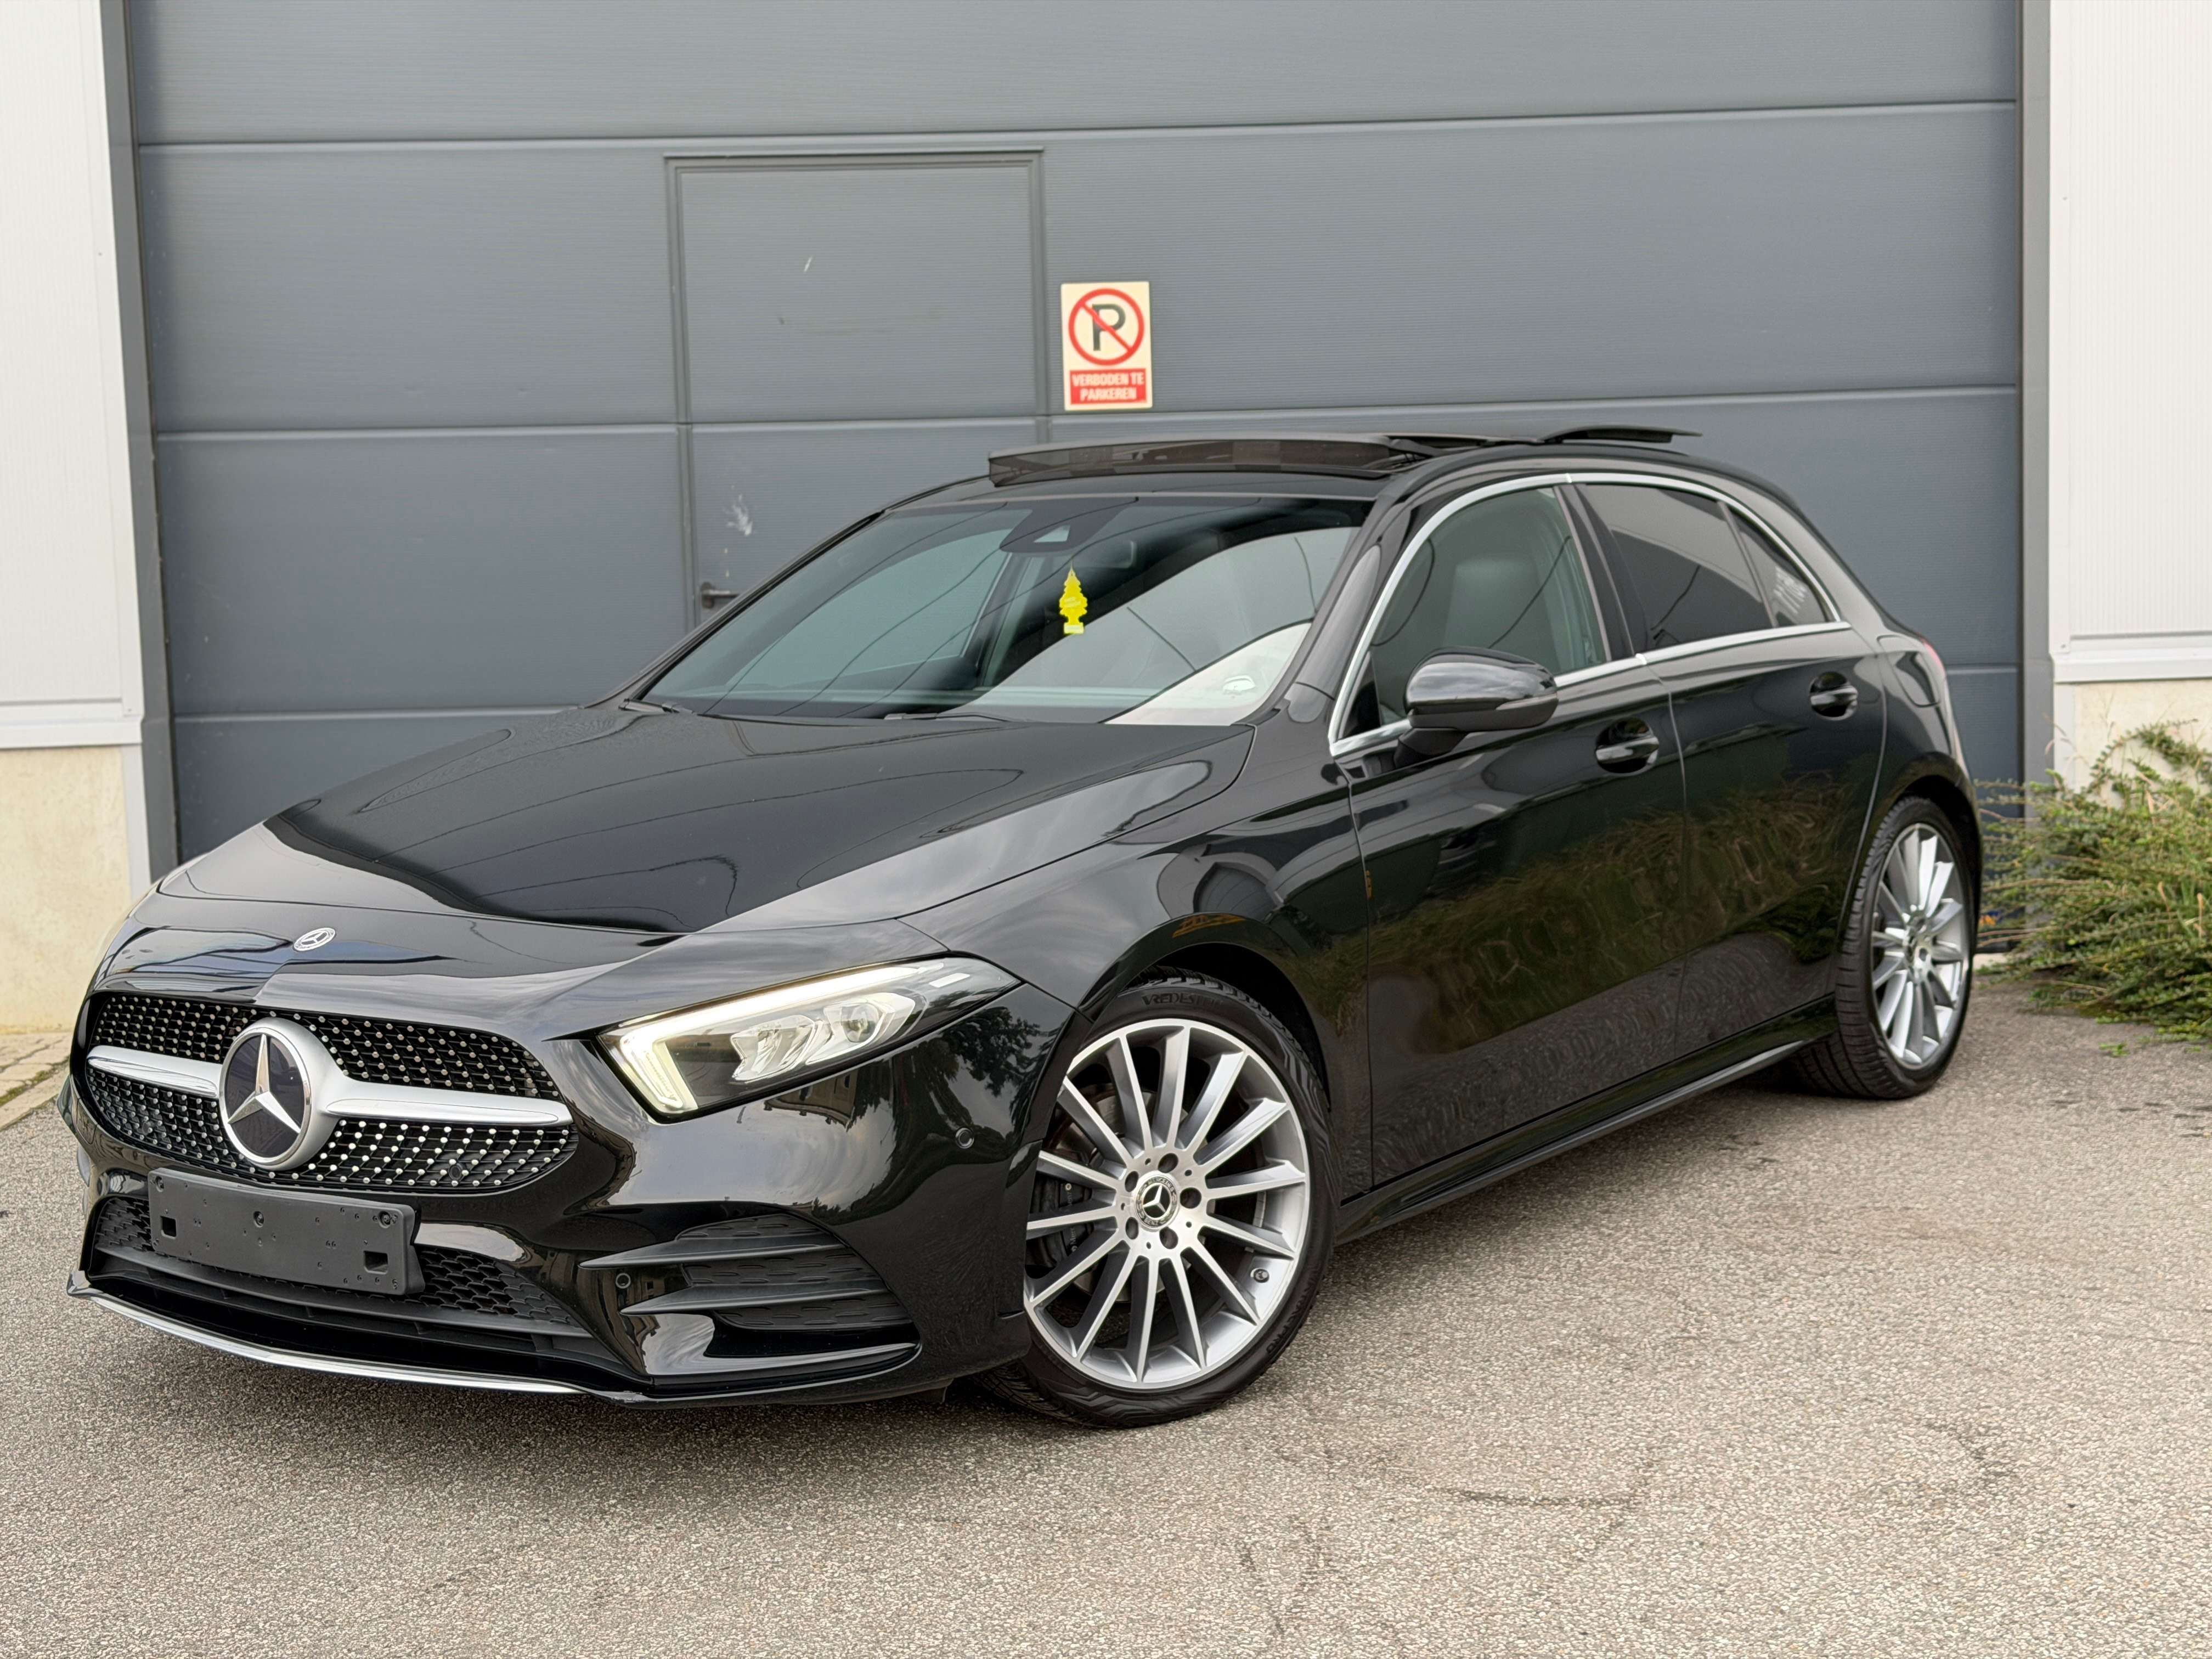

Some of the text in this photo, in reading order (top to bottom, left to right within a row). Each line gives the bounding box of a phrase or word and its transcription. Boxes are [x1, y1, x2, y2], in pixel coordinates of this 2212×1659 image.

[1092, 304, 1126, 351] P
[1072, 372, 1144, 386] VERBODEN TE
[1080, 387, 1137, 401] PARKEREN
[1142, 992, 1224, 1008] VREDEST
